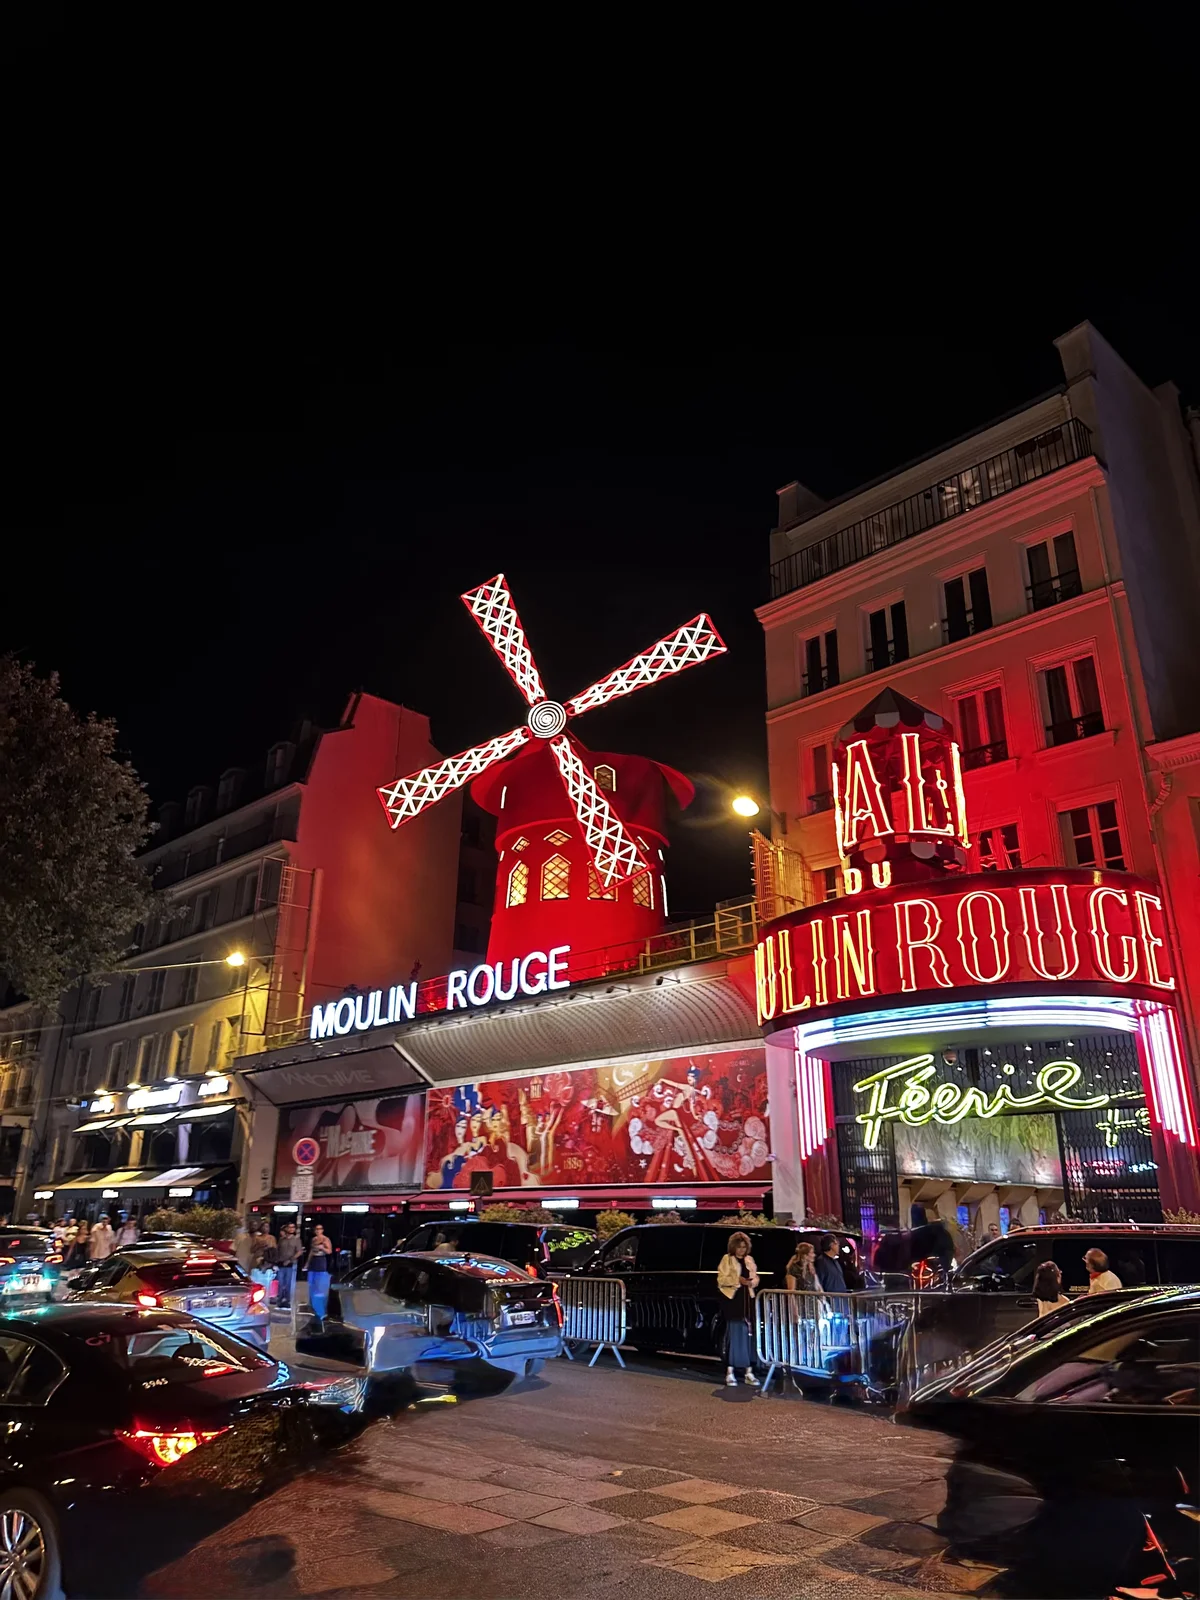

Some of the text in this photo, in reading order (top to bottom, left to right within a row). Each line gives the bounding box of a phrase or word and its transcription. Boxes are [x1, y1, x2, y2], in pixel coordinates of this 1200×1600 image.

[832, 733, 955, 860] AL
[843, 861, 892, 895] DU
[310, 945, 571, 1040] MOULIN ROUGE
[754, 884, 1178, 1026] ULIN ROUGE
[852, 1053, 1110, 1150] Féerie
[21, 1275, 41, 1286] TAXI
